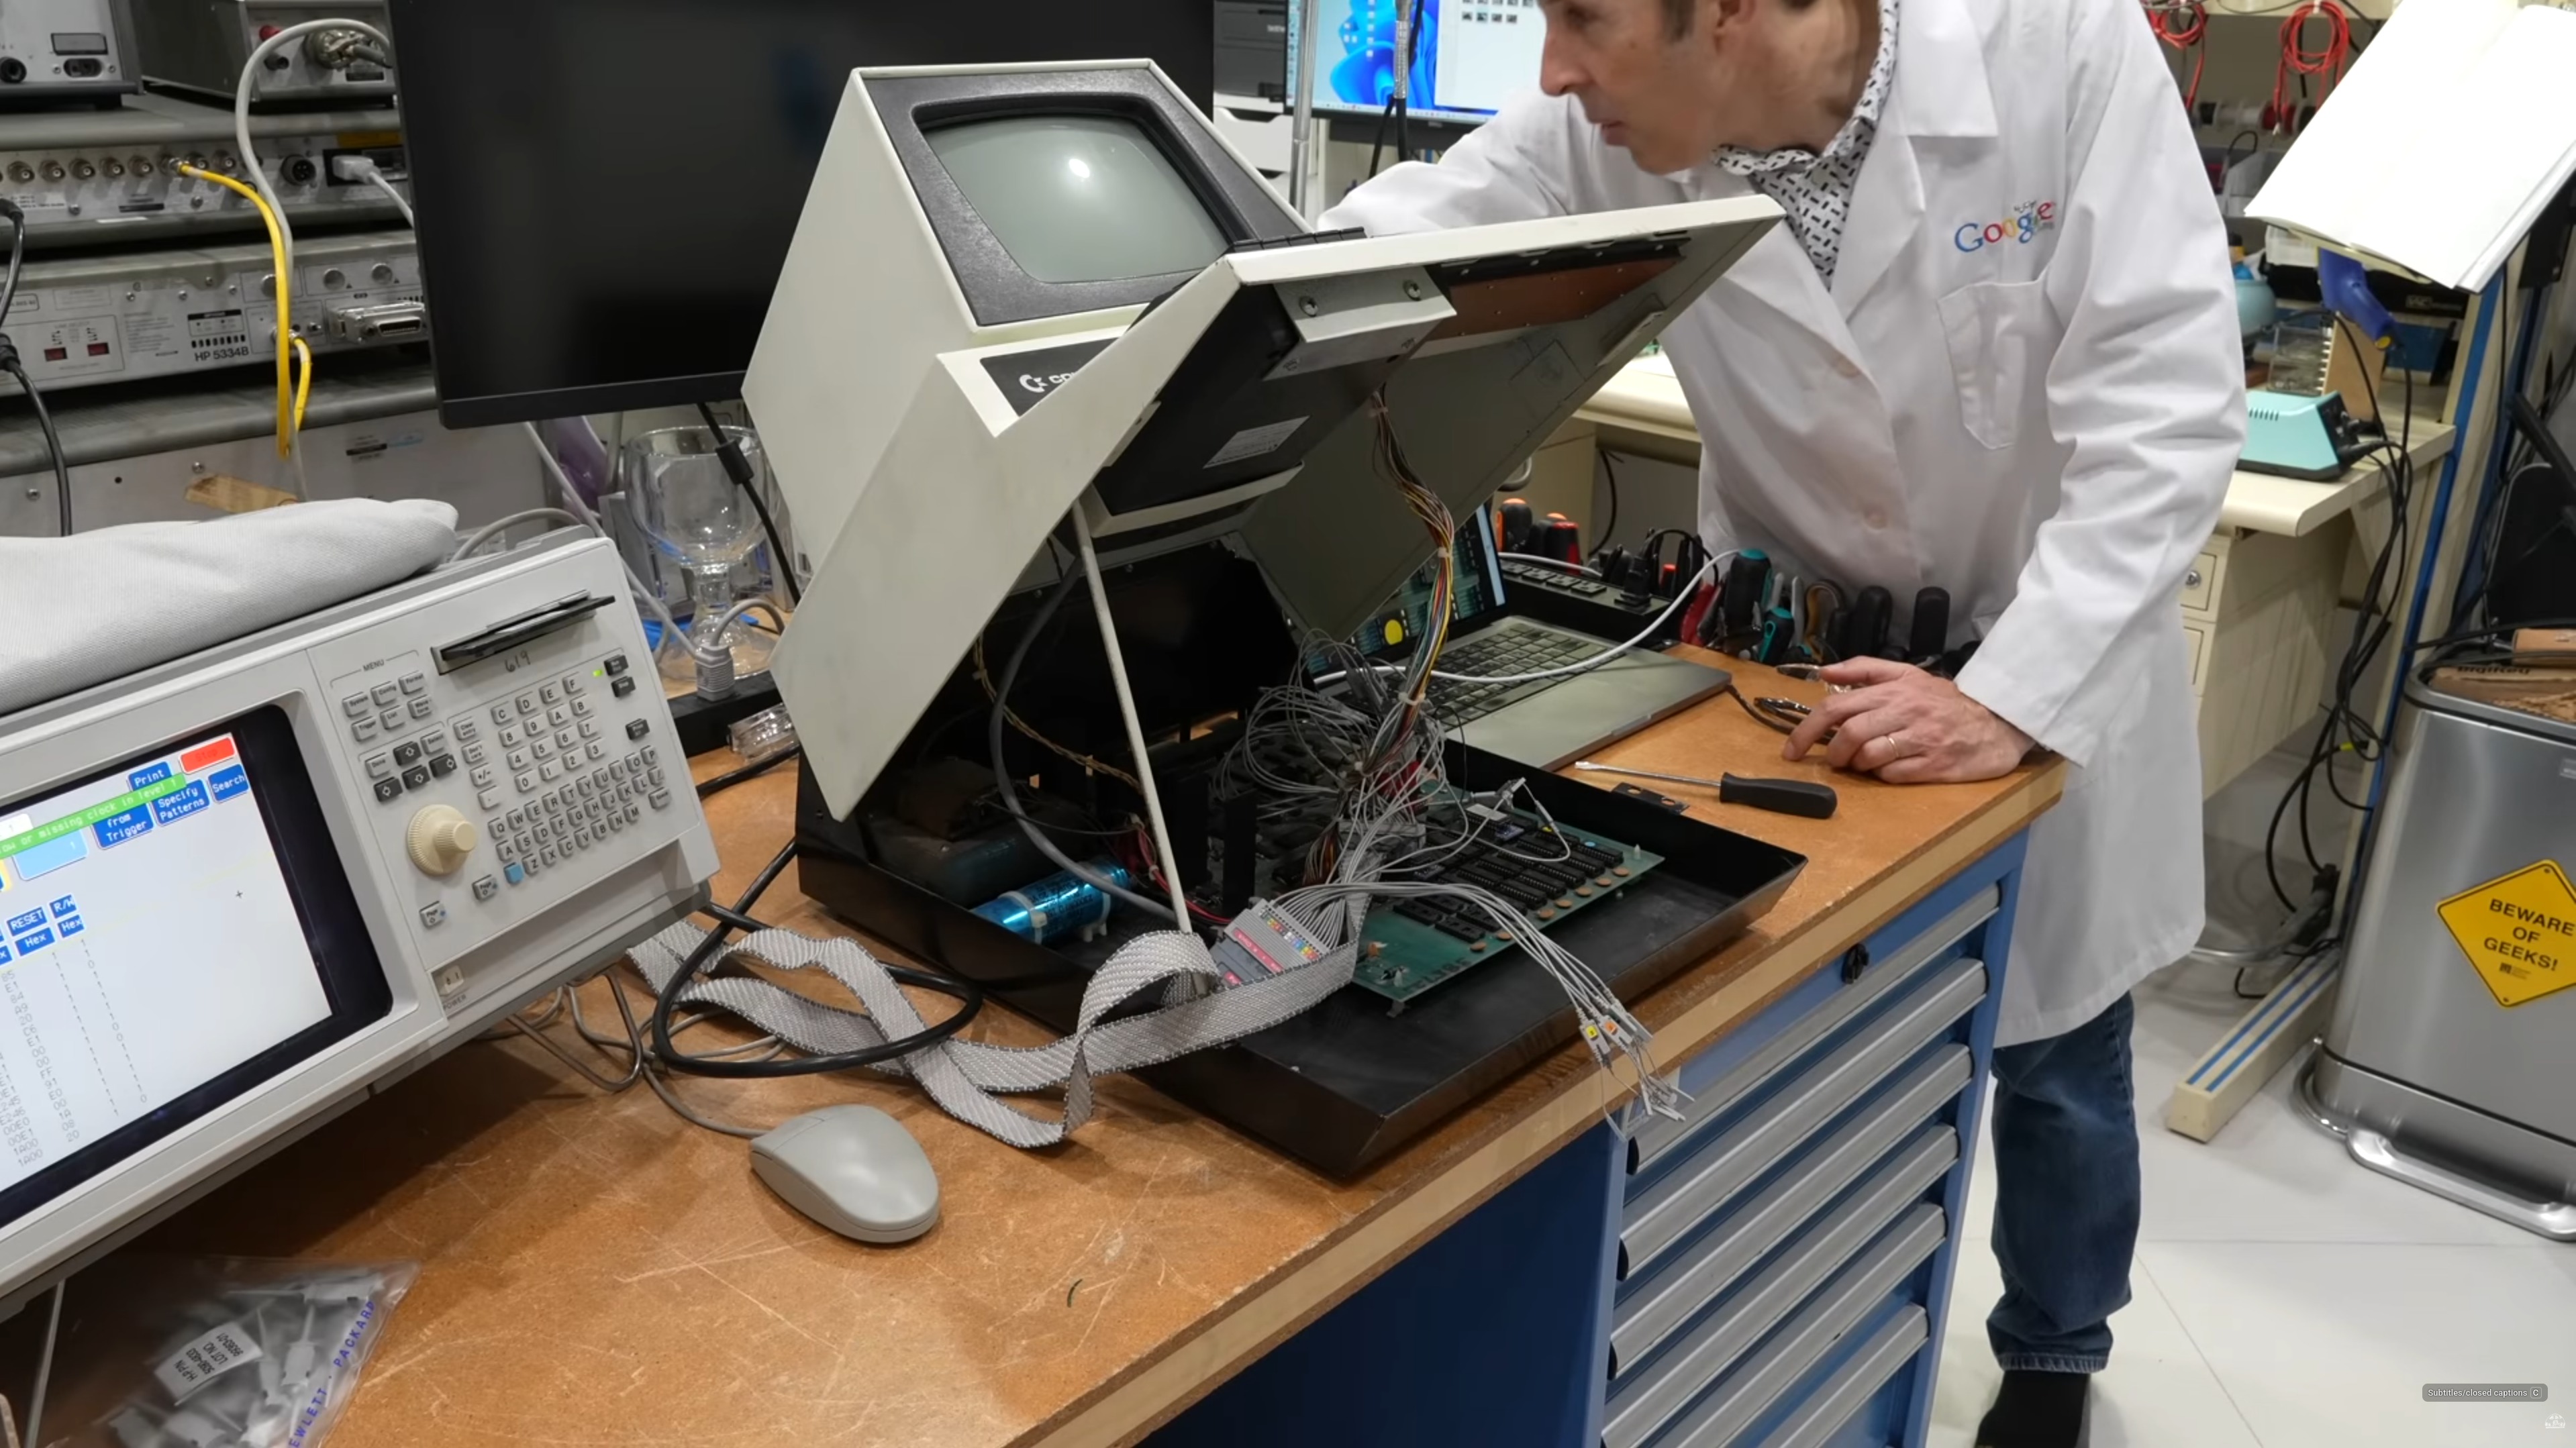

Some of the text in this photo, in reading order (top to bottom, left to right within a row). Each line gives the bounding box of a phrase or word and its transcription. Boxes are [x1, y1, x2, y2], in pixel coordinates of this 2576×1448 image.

[195, 346, 249, 362] HP 5334B
[362, 660, 385, 672] MENU
[505, 650, 531, 672] 619
[498, 679, 575, 719] C D E F
[387, 712, 397, 720] List
[506, 701, 585, 742] 8 9 A B
[515, 723, 590, 764] 4 5 6 7
[522, 778, 529, 788] 0
[569, 756, 576, 765] 2
[592, 745, 599, 755] 3
[134, 769, 165, 787] Print
[212, 774, 246, 793] Search
[158, 786, 199, 808] Specify
[497, 823, 505, 833] Q
[513, 813, 523, 824] W
[534, 805, 540, 815] E
[550, 797, 558, 807] R
[568, 789, 574, 798] T
[585, 780, 591, 790] Y
[601, 773, 609, 782] U
[633, 758, 640, 766] O
[650, 750, 655, 760] P
[21, 834, 33, 845] or
[38, 816, 83, 837] missing
[87, 802, 117, 820] clock
[122, 796, 134, 807] in
[138, 782, 165, 799] level
[159, 797, 205, 821] Patterns
[506, 780, 647, 856] A S D F G H J K L
[106, 820, 147, 842] Trigger
[107, 813, 132, 829] from
[531, 807, 639, 869] Z X C V B N M
[10, 910, 43, 931] RESET
[2489, 898, 2575, 937] BEWARE
[25, 919, 83, 947] Hex Hex
[2512, 926, 2540, 943] OF
[2483, 937, 2559, 972] GEEKS!
[444, 994, 466, 1011] POWER
[3, 1117, 30, 1135] 00E0
[8, 1128, 34, 1147] 00E1
[13, 1138, 38, 1155] 1A00
[18, 1149, 43, 1166] 1A00
[333, 1300, 375, 1368] PACKARD
[210, 1351, 229, 1365] LOT
